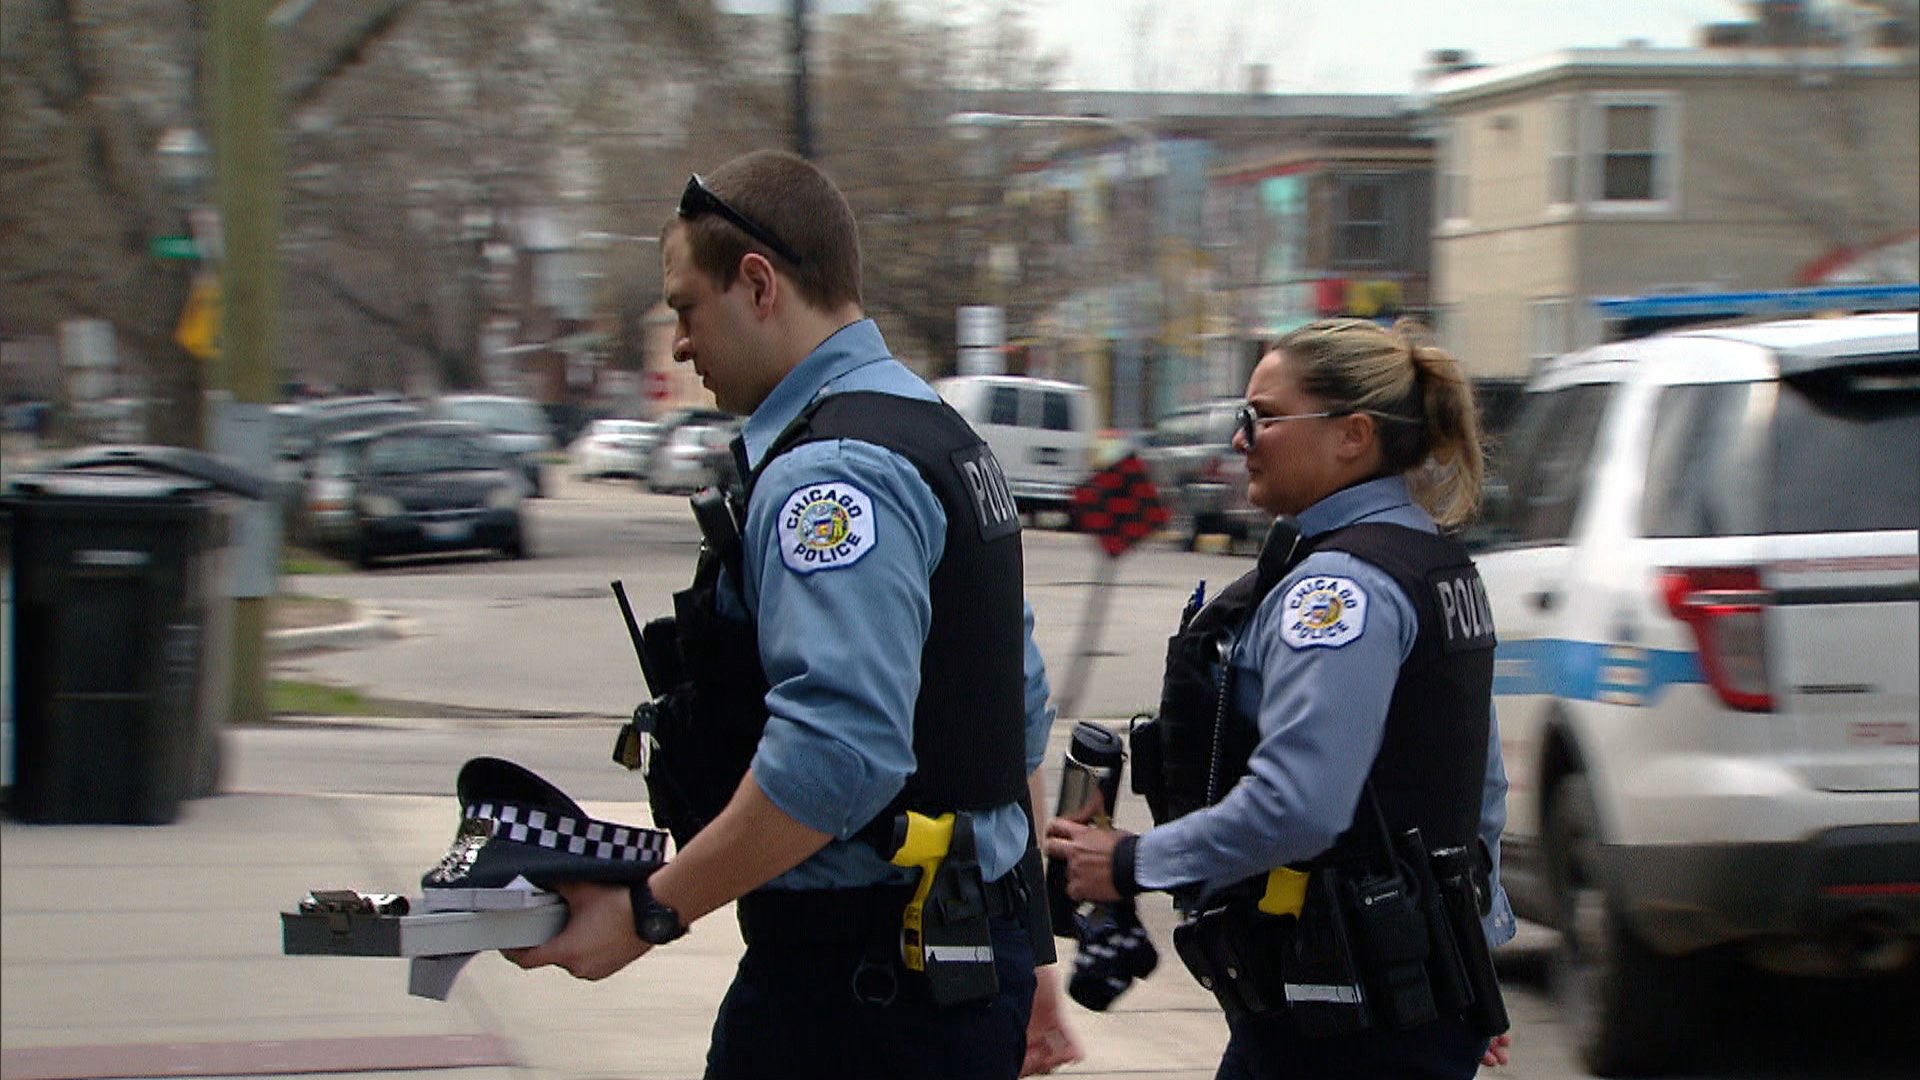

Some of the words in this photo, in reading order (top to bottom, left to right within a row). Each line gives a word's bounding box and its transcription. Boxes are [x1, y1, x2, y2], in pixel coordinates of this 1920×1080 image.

[786, 489, 863, 529] CHICAGO
[792, 532, 862, 563] POLICE
[1290, 579, 1358, 609] CHICAGO
